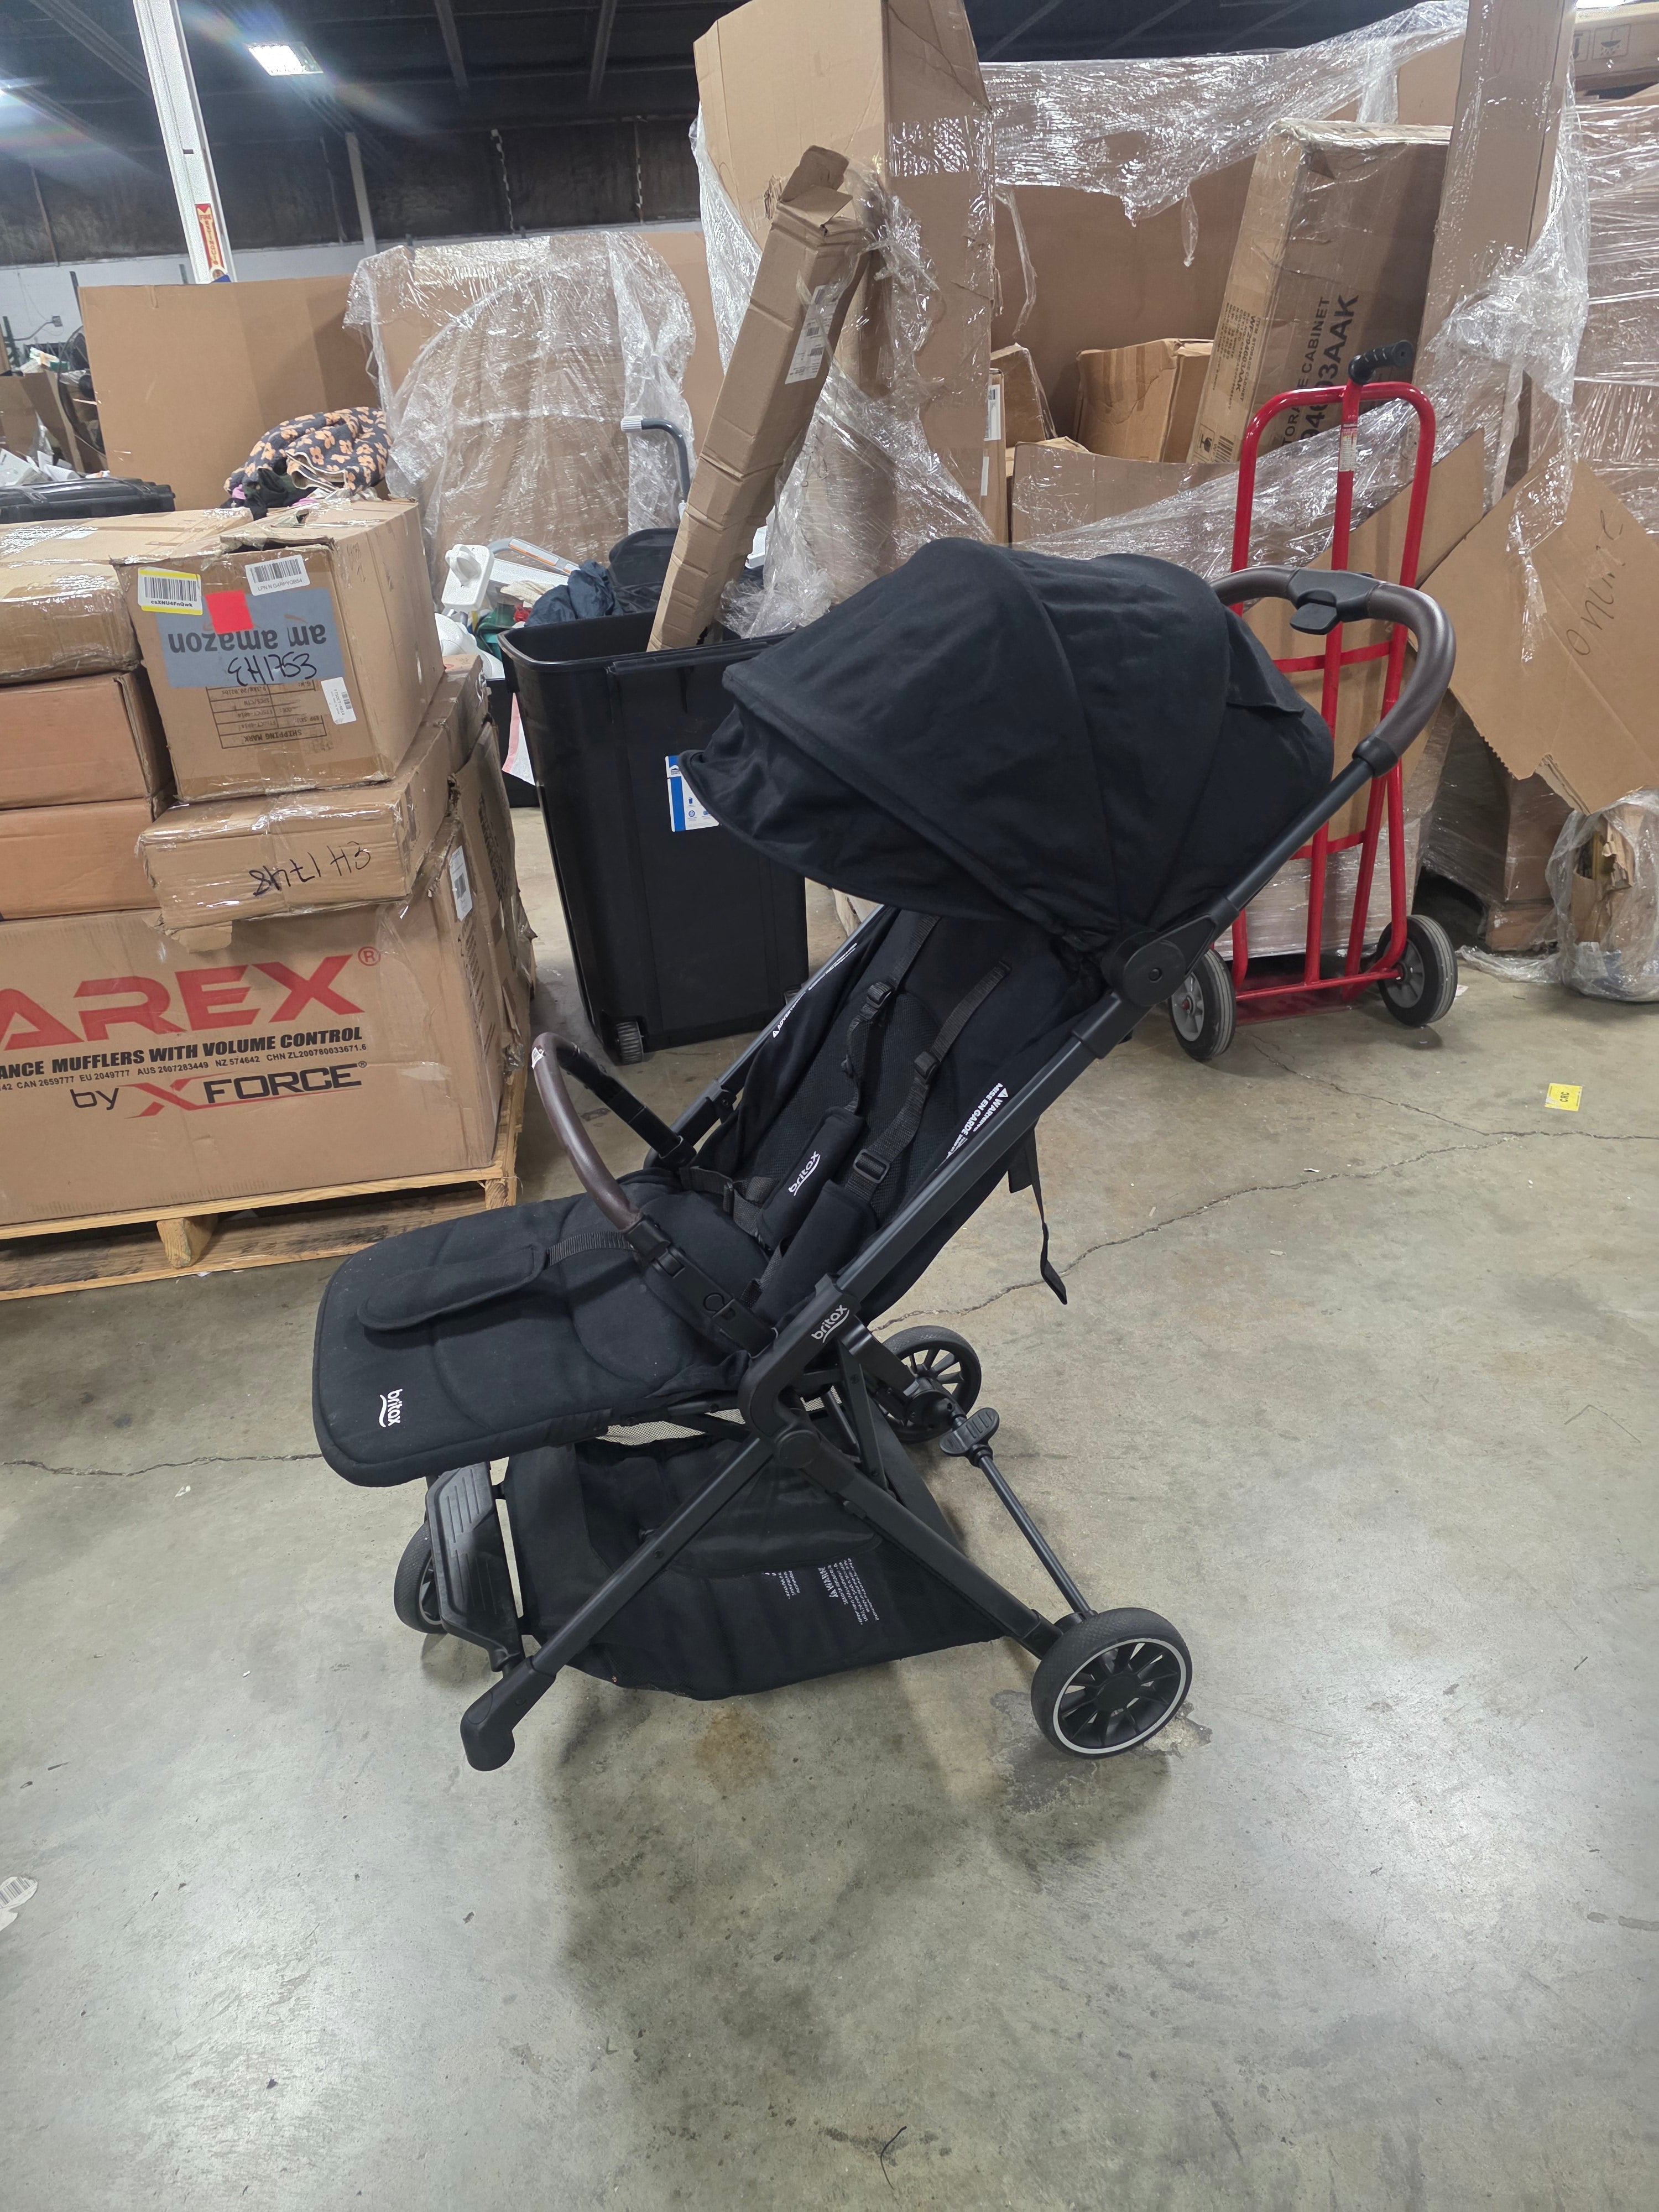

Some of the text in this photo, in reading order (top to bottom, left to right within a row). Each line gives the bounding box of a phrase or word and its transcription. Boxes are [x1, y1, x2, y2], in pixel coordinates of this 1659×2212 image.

[1302, 297, 1329, 373] CABINET
[1236, 316, 1256, 392] WF294603AAK
[1247, 338, 1256, 371] STORAGE
[1239, 372, 1249, 402] CABINET
[168, 629, 278, 653] amazon
[243, 729, 302, 742] SHIPPING MARK
[38, 1076, 74, 1087] 2659777
[80, 1073, 92, 1082] EU
[94, 1070, 130, 1079] 2049777
[137, 1066, 156, 1075] AUS
[158, 1061, 209, 1074] 2007283449
[229, 1056, 260, 1066] 574642
[266, 1053, 286, 1062] CHN
[287, 1044, 367, 1059] ZL200780033671.6
[52, 1050, 144, 1073] MUFFLERS
[149, 1044, 198, 1062] WITH
[202, 1036, 276, 1057] VOLUME
[280, 1026, 362, 1048] CONTROL
[70, 1088, 119, 1110] by
[961, 1083, 1003, 1136] MISE EN GARDE
[1559, 1092, 1569, 1102] CRC
[789, 1151, 820, 1193] britax
[811, 1305, 848, 1339] britax
[387, 1389, 403, 1426] britax
